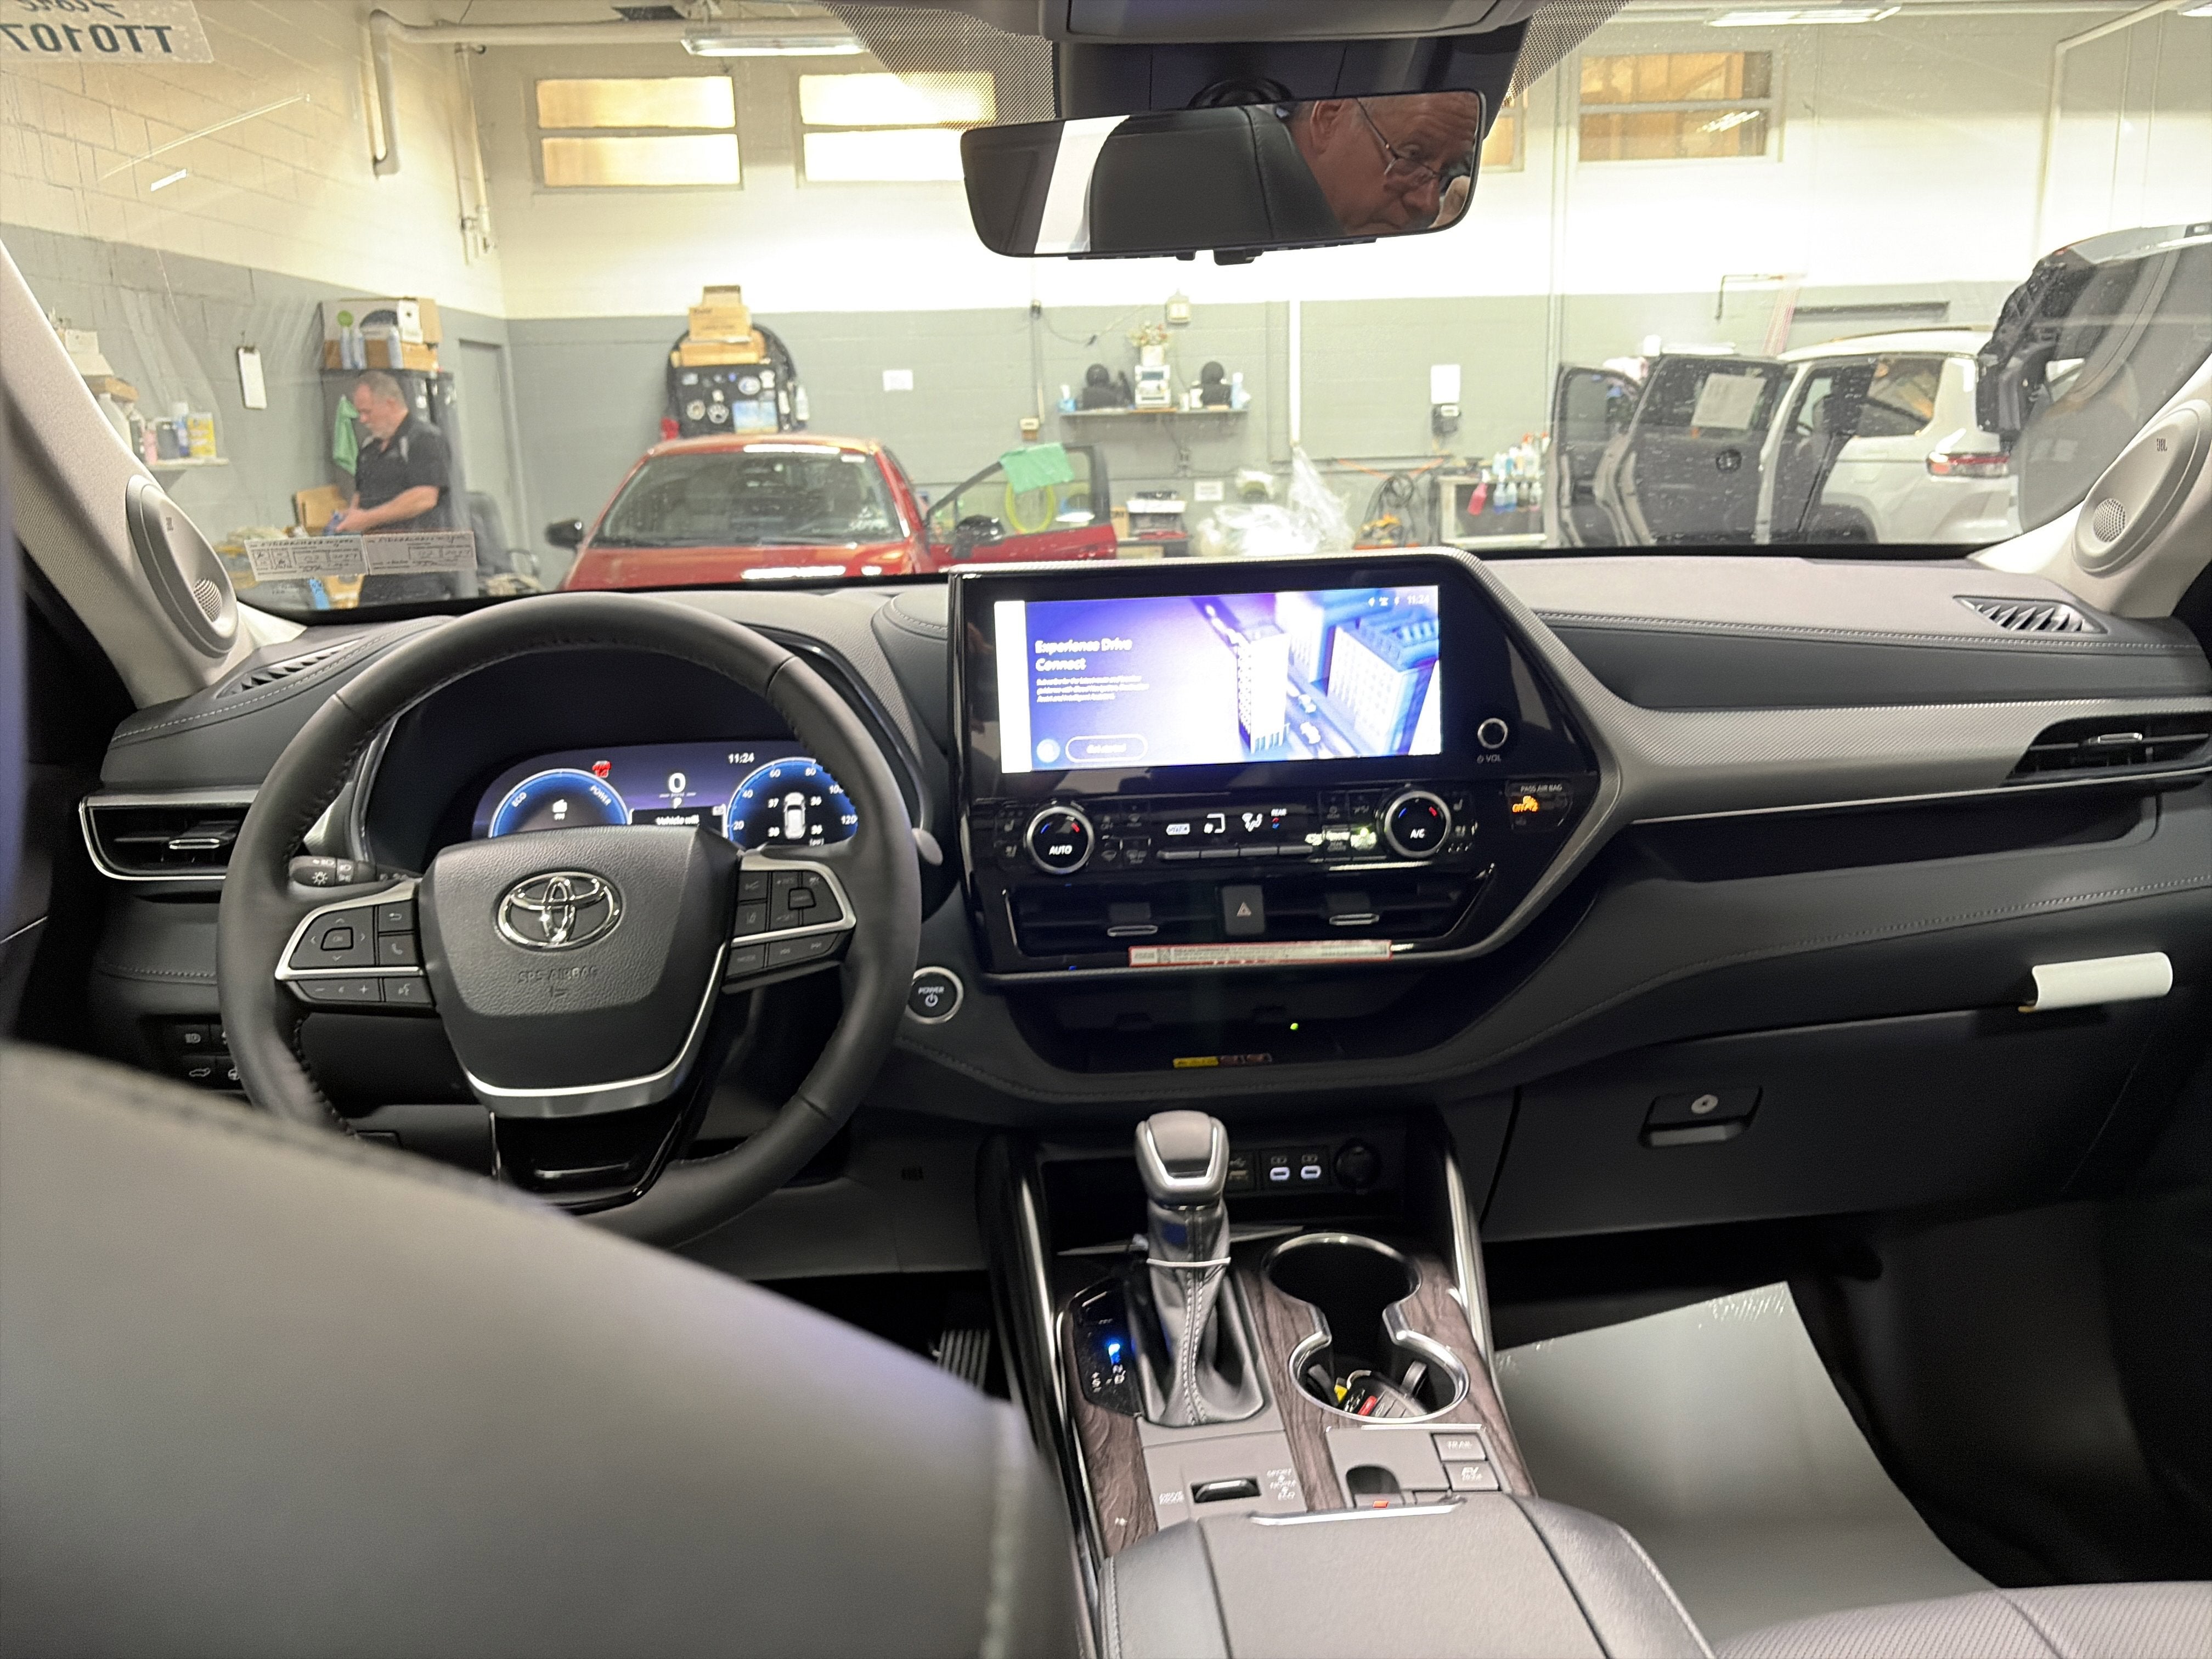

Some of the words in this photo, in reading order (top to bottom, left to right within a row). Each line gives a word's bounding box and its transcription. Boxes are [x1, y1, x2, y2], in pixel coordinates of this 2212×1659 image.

[2157, 438, 2168, 452] JBL
[1035, 639, 1100, 656] Experience
[1101, 637, 1132, 651] Drive
[1035, 658, 1086, 672] Connect
[728, 752, 755, 764] 11:24
[1486, 754, 1502, 763] VOL
[770, 769, 781, 778] 60
[668, 772, 686, 793] 0
[589, 785, 612, 806] POWER
[742, 789, 754, 798] 40
[511, 792, 527, 808] ECO
[673, 797, 682, 809] P
[733, 820, 744, 831] 20
[840, 815, 858, 825] 120
[1410, 828, 1425, 839] A/C
[1048, 845, 1073, 855] AUTO
[918, 986, 945, 994] POWER
[1447, 1441, 1473, 1449] TRAIL
[1462, 1466, 1479, 1475] EV
[1277, 1491, 1296, 1501] ECO
